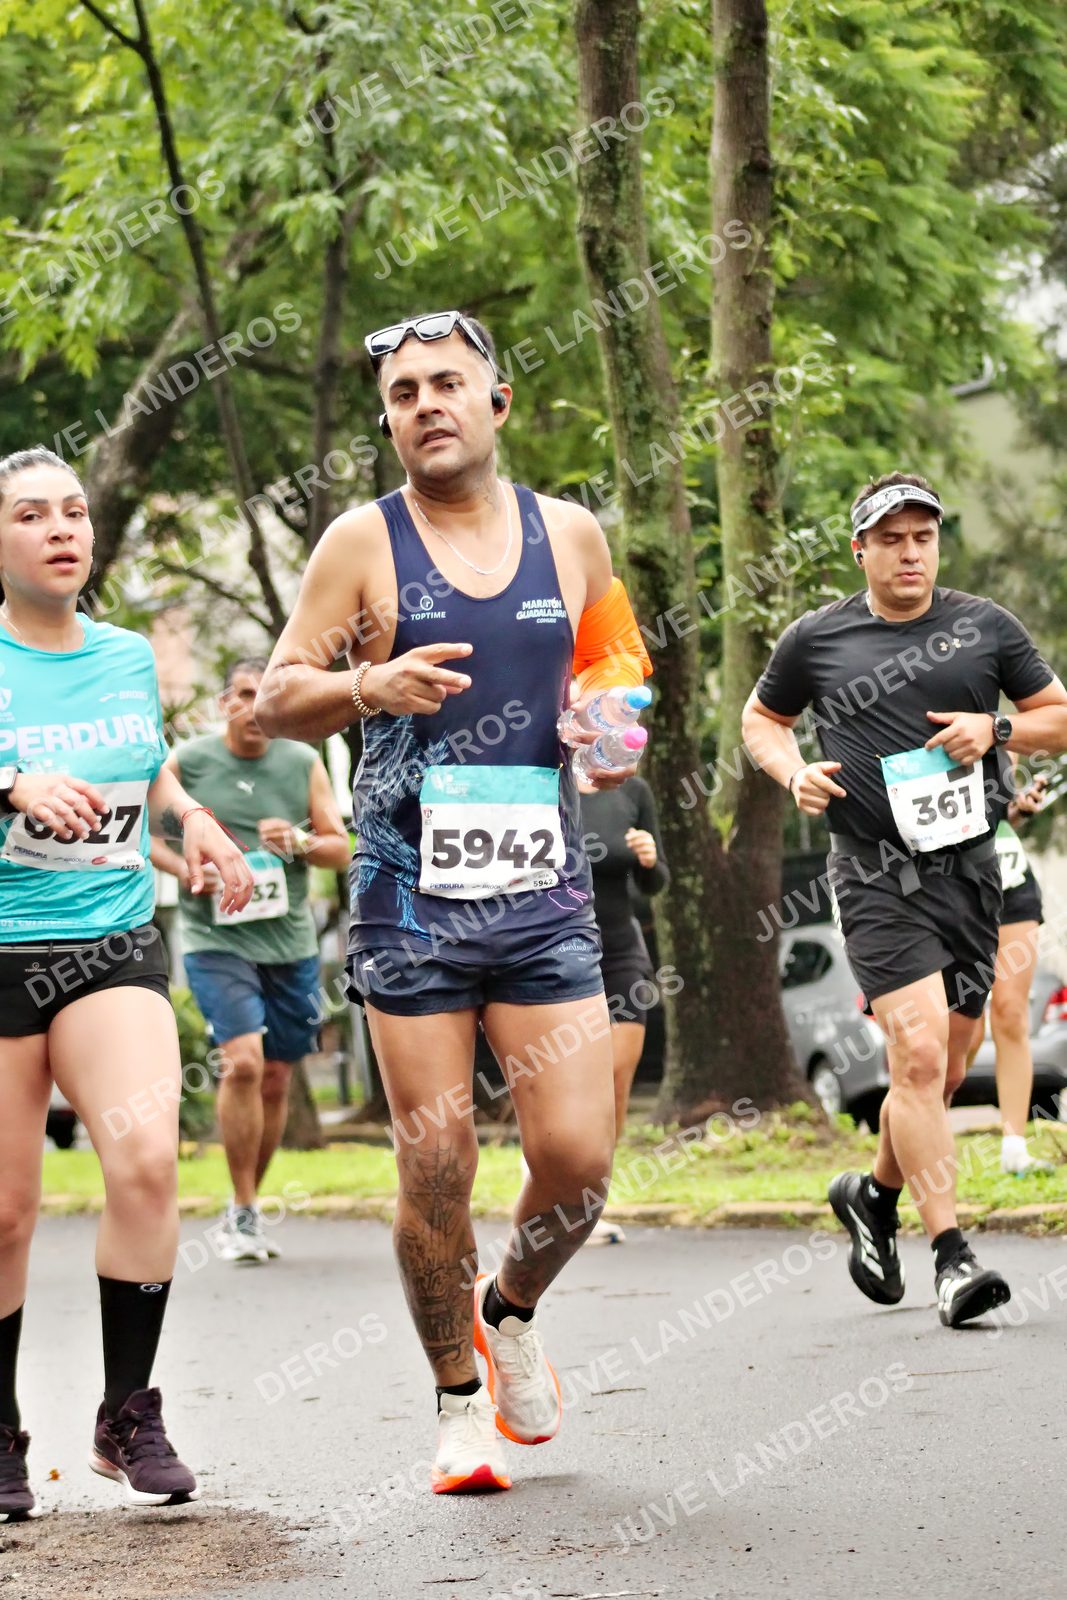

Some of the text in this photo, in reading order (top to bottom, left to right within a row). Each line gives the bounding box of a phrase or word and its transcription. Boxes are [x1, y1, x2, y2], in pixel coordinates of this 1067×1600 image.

[411, 611, 446, 620] TOPTIME
[912, 785, 972, 826] 361
[431, 828, 556, 869] 5942
[533, 879, 553, 888] 5942
